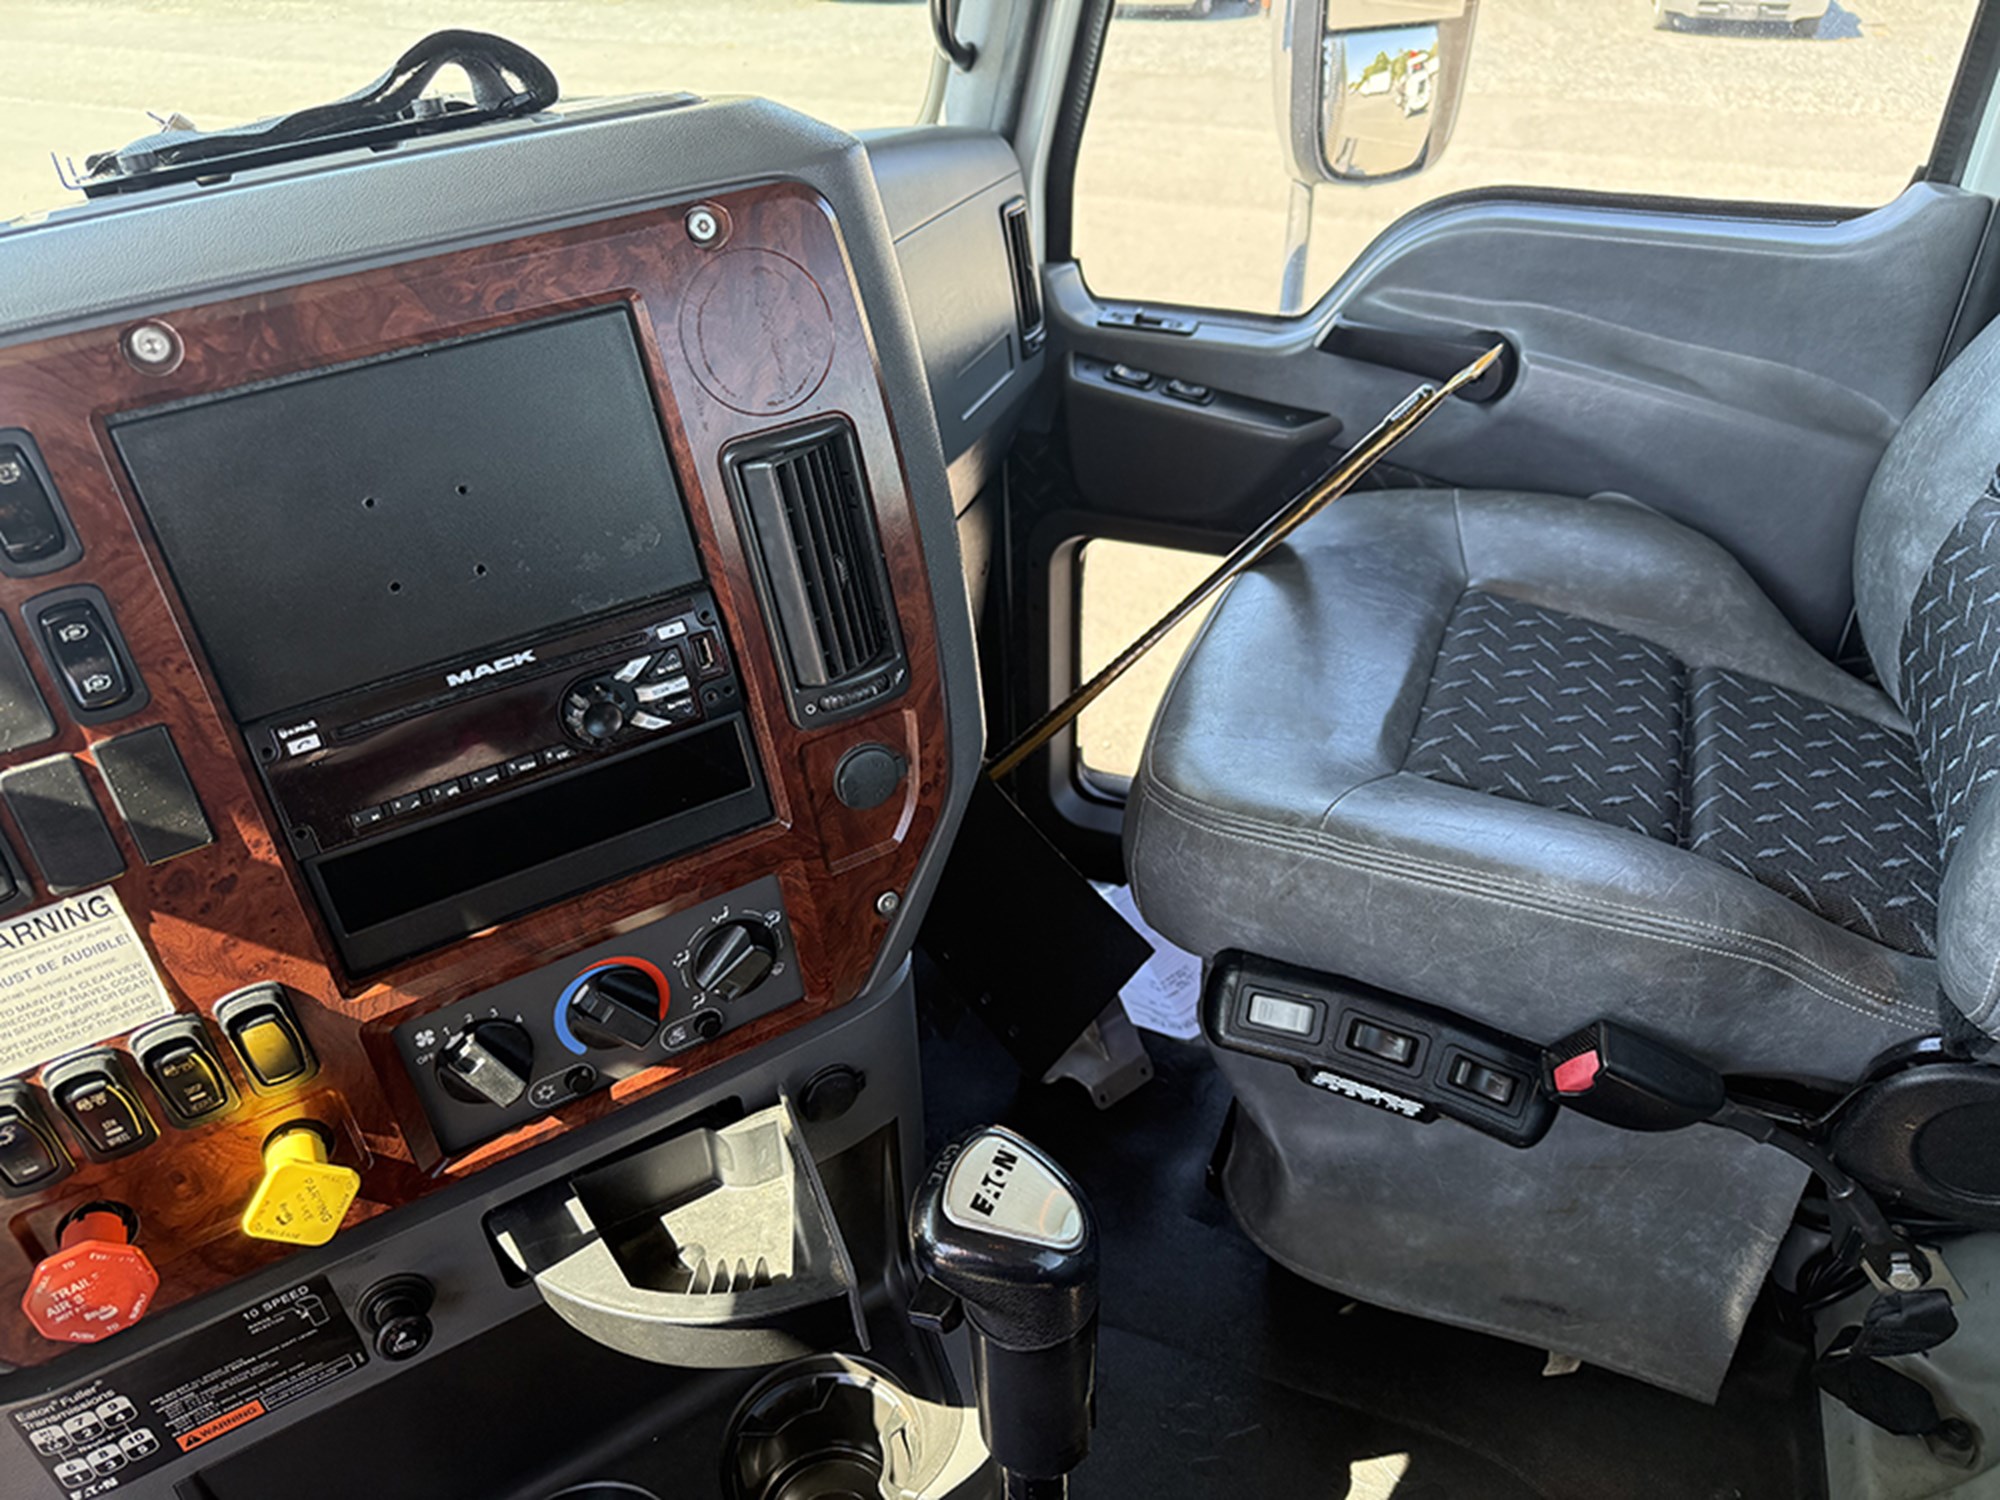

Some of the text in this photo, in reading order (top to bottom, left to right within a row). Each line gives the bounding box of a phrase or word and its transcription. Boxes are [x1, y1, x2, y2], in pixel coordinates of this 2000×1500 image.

[446, 649, 537, 687] MACK
[35, 959, 59, 976] BE
[61, 933, 132, 966] AUDIBLE!
[15, 989, 67, 1013] MAINTAIN
[78, 970, 114, 990] CLEAR
[116, 961, 143, 976] VIEW
[51, 999, 66, 1011] OF
[69, 985, 108, 1003] TRAVEL
[110, 970, 148, 988] COULD
[13, 1012, 62, 1035] SERIOUS
[102, 990, 118, 1003] OR
[65, 1002, 129, 1030] RESPONSIBLE
[131, 993, 151, 1006] FOR
[464, 1013, 474, 1024] 2
[489, 1007, 498, 1018] 3
[515, 1013, 523, 1023] 4
[25, 1027, 80, 1054] OPERATION
[98, 1014, 119, 1028] THIS
[969, 1148, 1020, 1218] EATON
[46, 1300, 74, 1319] AIR
[243, 1284, 310, 1321] 10 SPEED
[22, 1389, 116, 1431] Transmissions
[74, 1402, 118, 1427] 7 9
[82, 1412, 126, 1438] 2 4
[200, 1406, 257, 1438] WARNING
[66, 1464, 77, 1474] 6
[127, 1433, 144, 1445] 10
